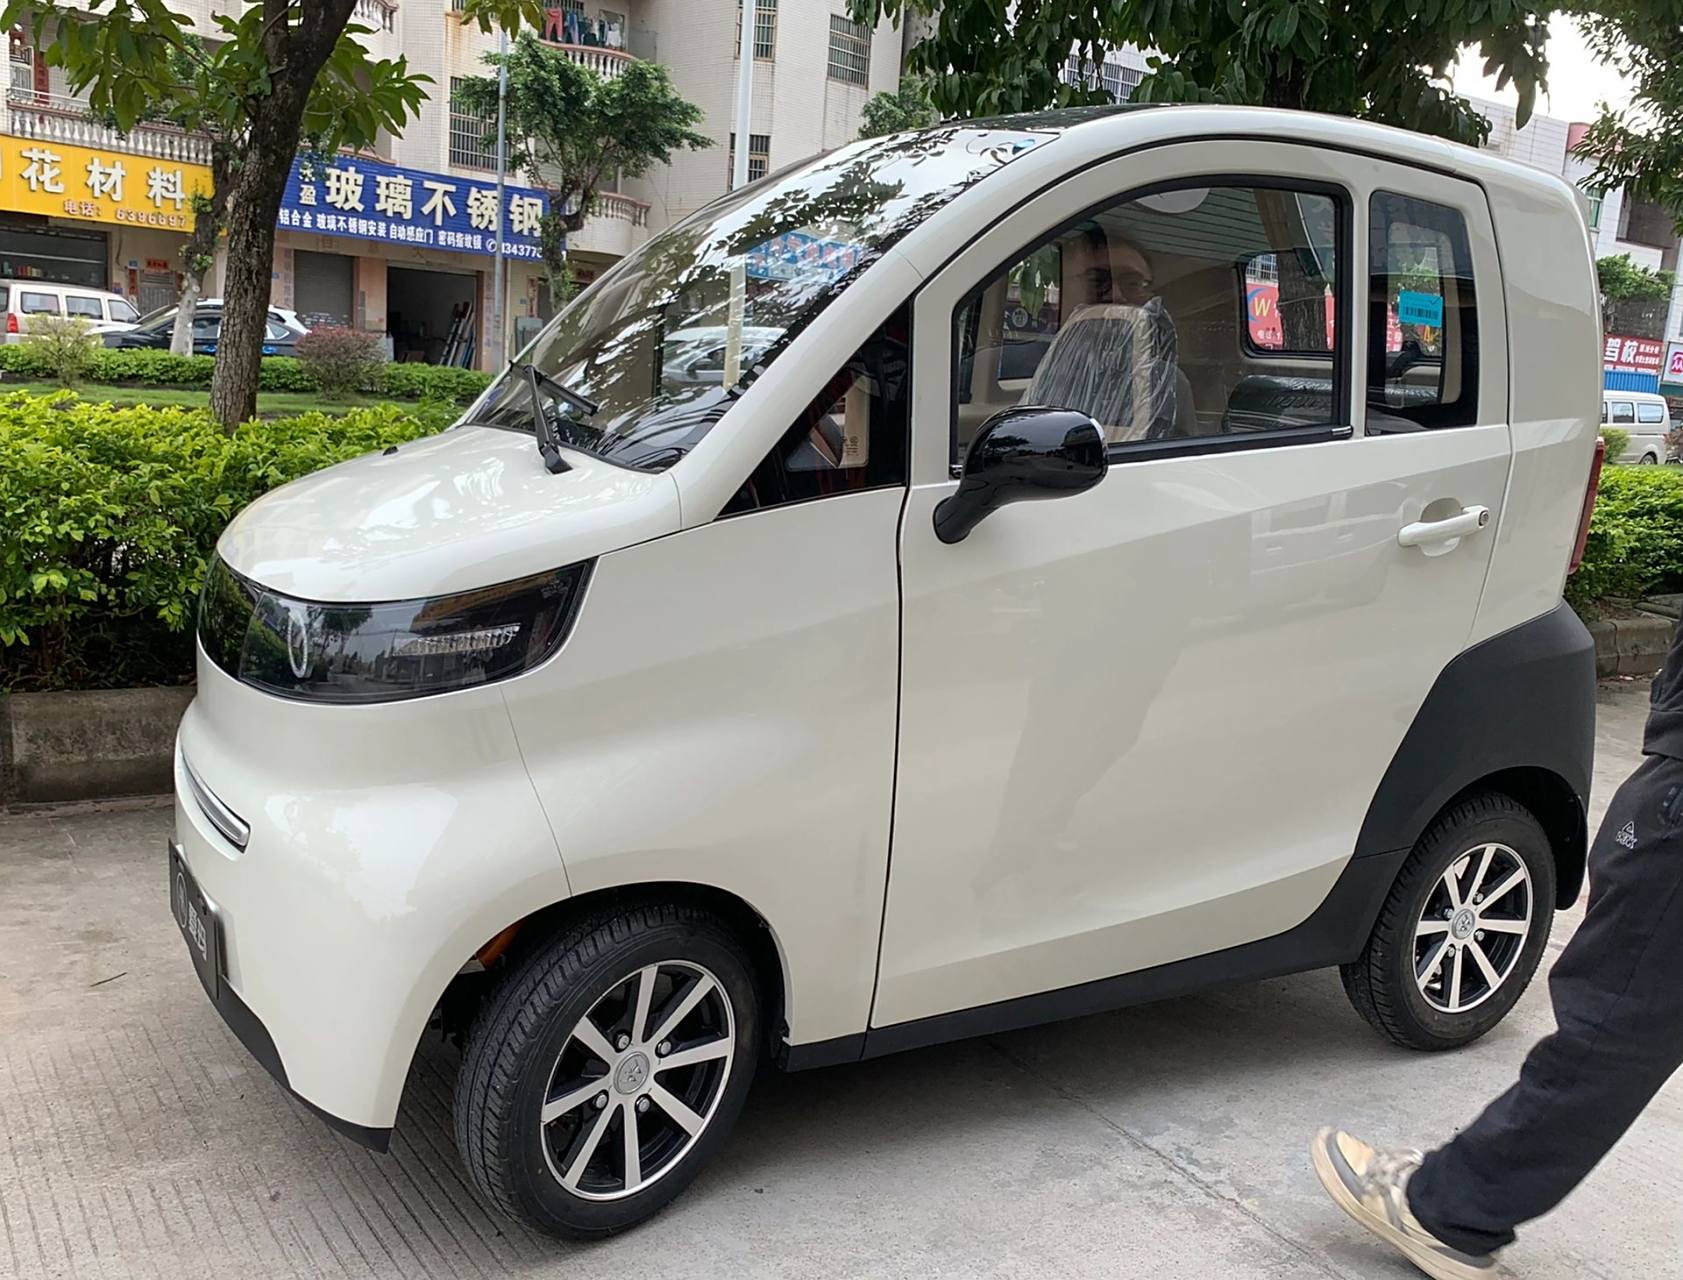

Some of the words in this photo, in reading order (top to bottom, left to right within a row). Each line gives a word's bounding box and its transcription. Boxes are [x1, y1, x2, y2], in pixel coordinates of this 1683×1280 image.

[0, 147, 186, 210] 花材料
[325, 166, 543, 238] 玻璃不锈钢
[279, 208, 312, 228] 铝合金
[316, 213, 387, 237] 玻璃不锈钢安装
[389, 222, 433, 244] 自动感应门
[1604, 338, 1638, 364] 驾校
